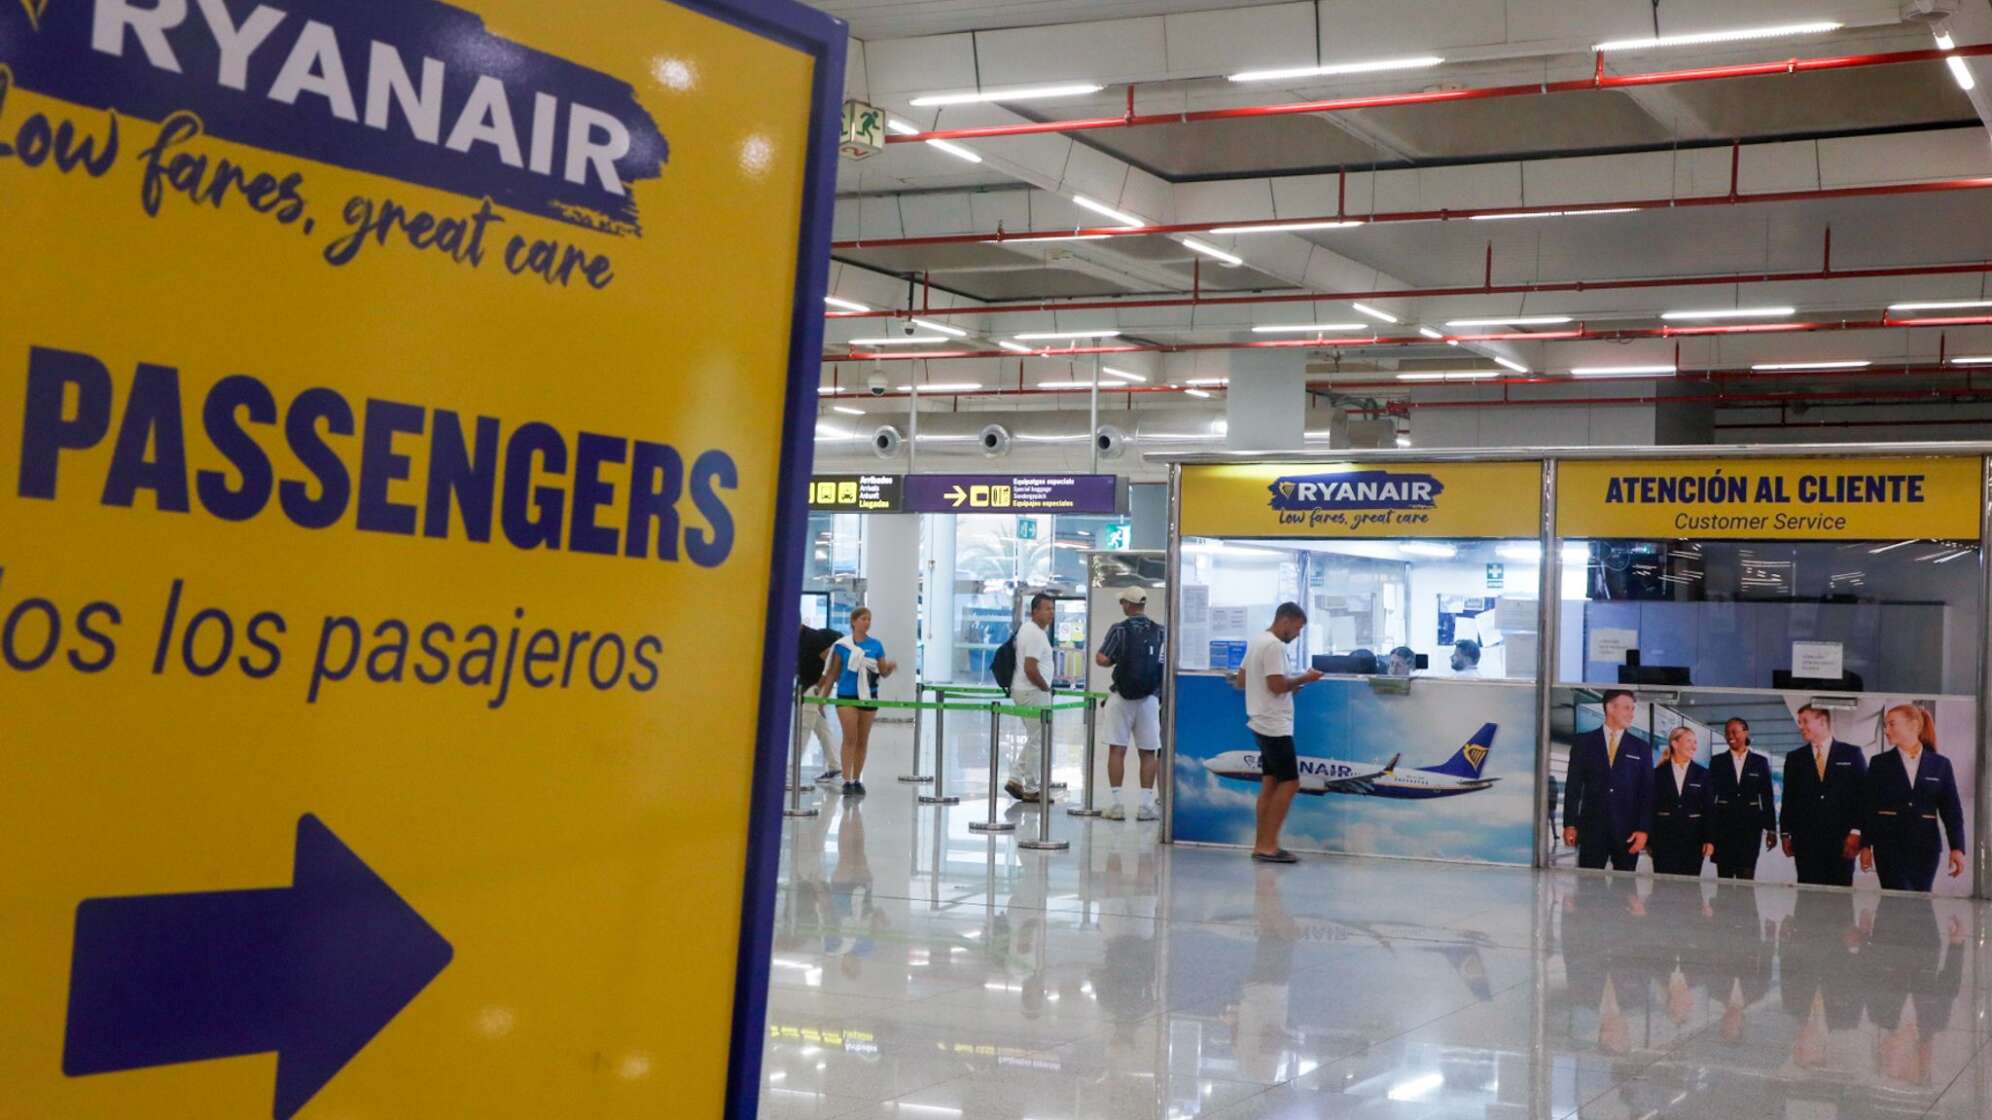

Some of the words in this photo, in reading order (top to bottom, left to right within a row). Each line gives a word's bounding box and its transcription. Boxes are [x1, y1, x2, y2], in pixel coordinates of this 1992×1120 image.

[91, 0, 632, 197] RYANAIR
[137, 114, 315, 236] fares,
[324, 197, 504, 266] great
[505, 221, 614, 290] care
[17, 345, 739, 569] PASSENGERS
[1297, 482, 1432, 502] RYANAIR
[1605, 468, 1748, 504] ATENCIÓN
[1754, 474, 1791, 504] AL
[1798, 474, 1926, 504] CLIENTE
[1279, 508, 1305, 525] Low
[1350, 510, 1395, 530] great
[1396, 512, 1429, 524] care
[1674, 512, 1769, 530] Customer
[1773, 512, 1847, 530] Service
[152, 578, 287, 679] los
[307, 606, 662, 709] pasajeros
